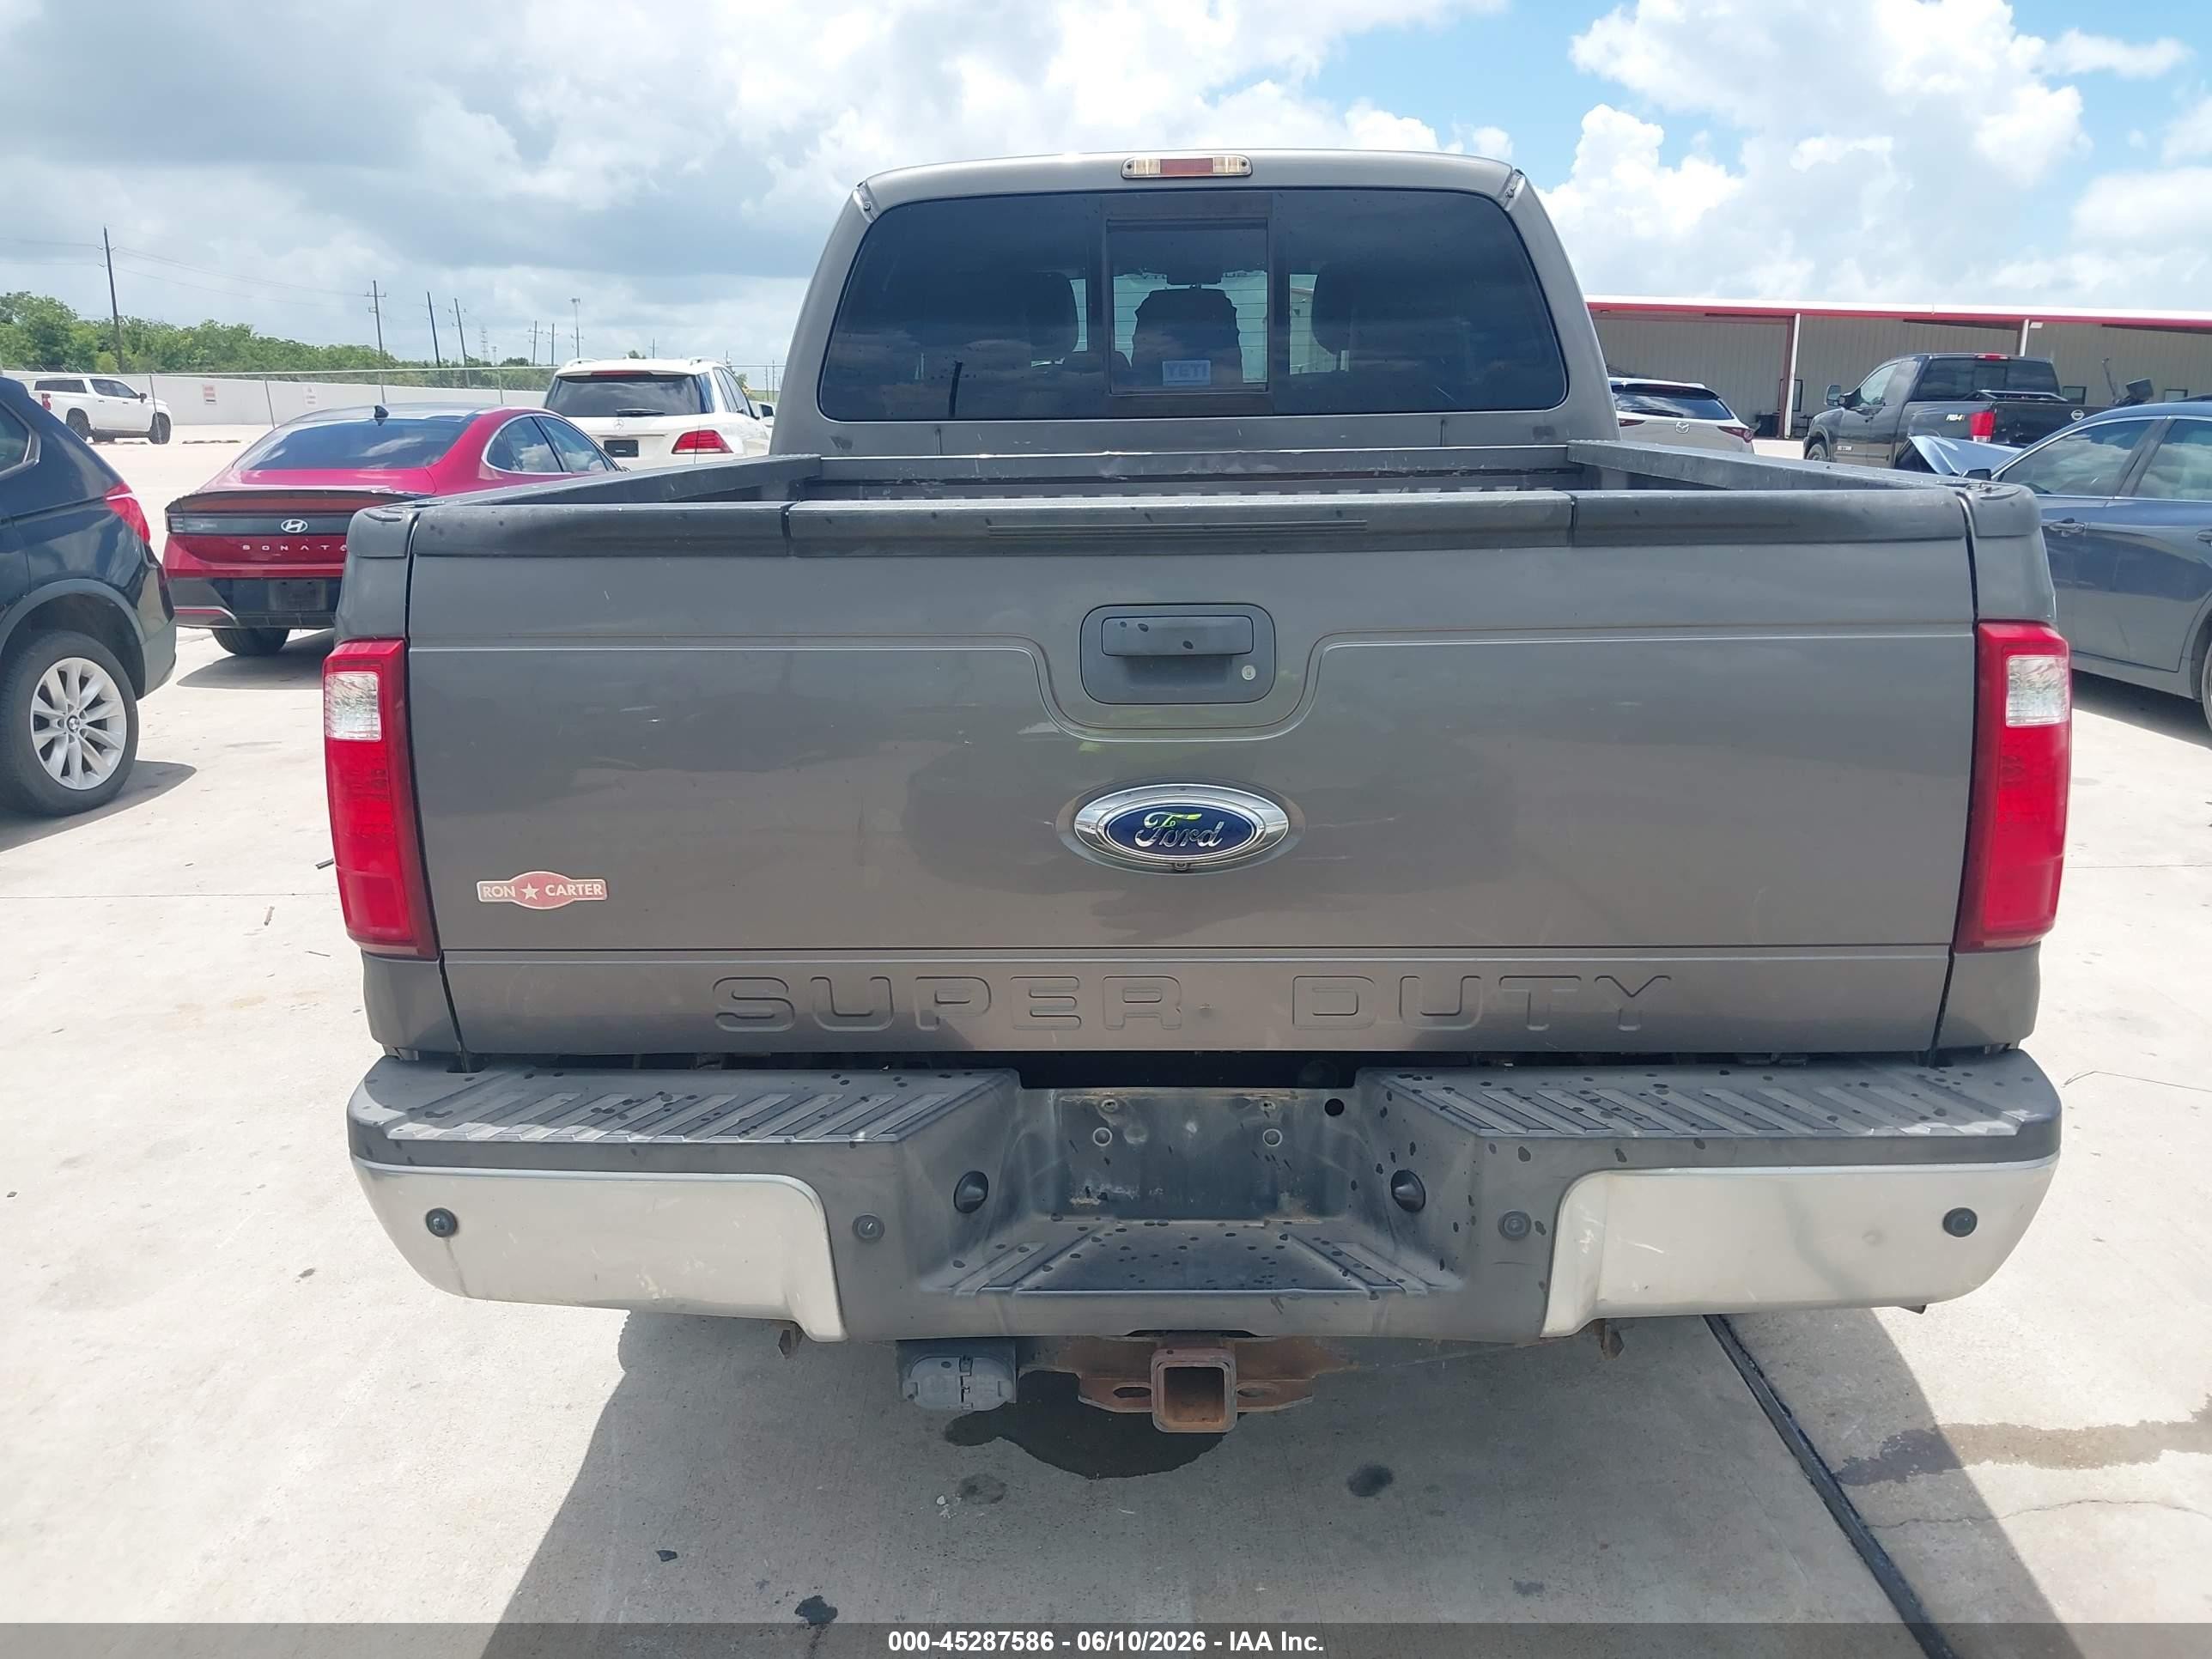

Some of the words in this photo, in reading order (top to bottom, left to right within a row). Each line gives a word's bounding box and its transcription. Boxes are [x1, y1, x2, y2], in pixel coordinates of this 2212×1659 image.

[1134, 811, 1224, 848] Ford
[482, 885, 515, 898] RON
[544, 884, 603, 896] CARTER
[712, 975, 1182, 1031] SUPER
[1291, 975, 1672, 1031] DUTY
